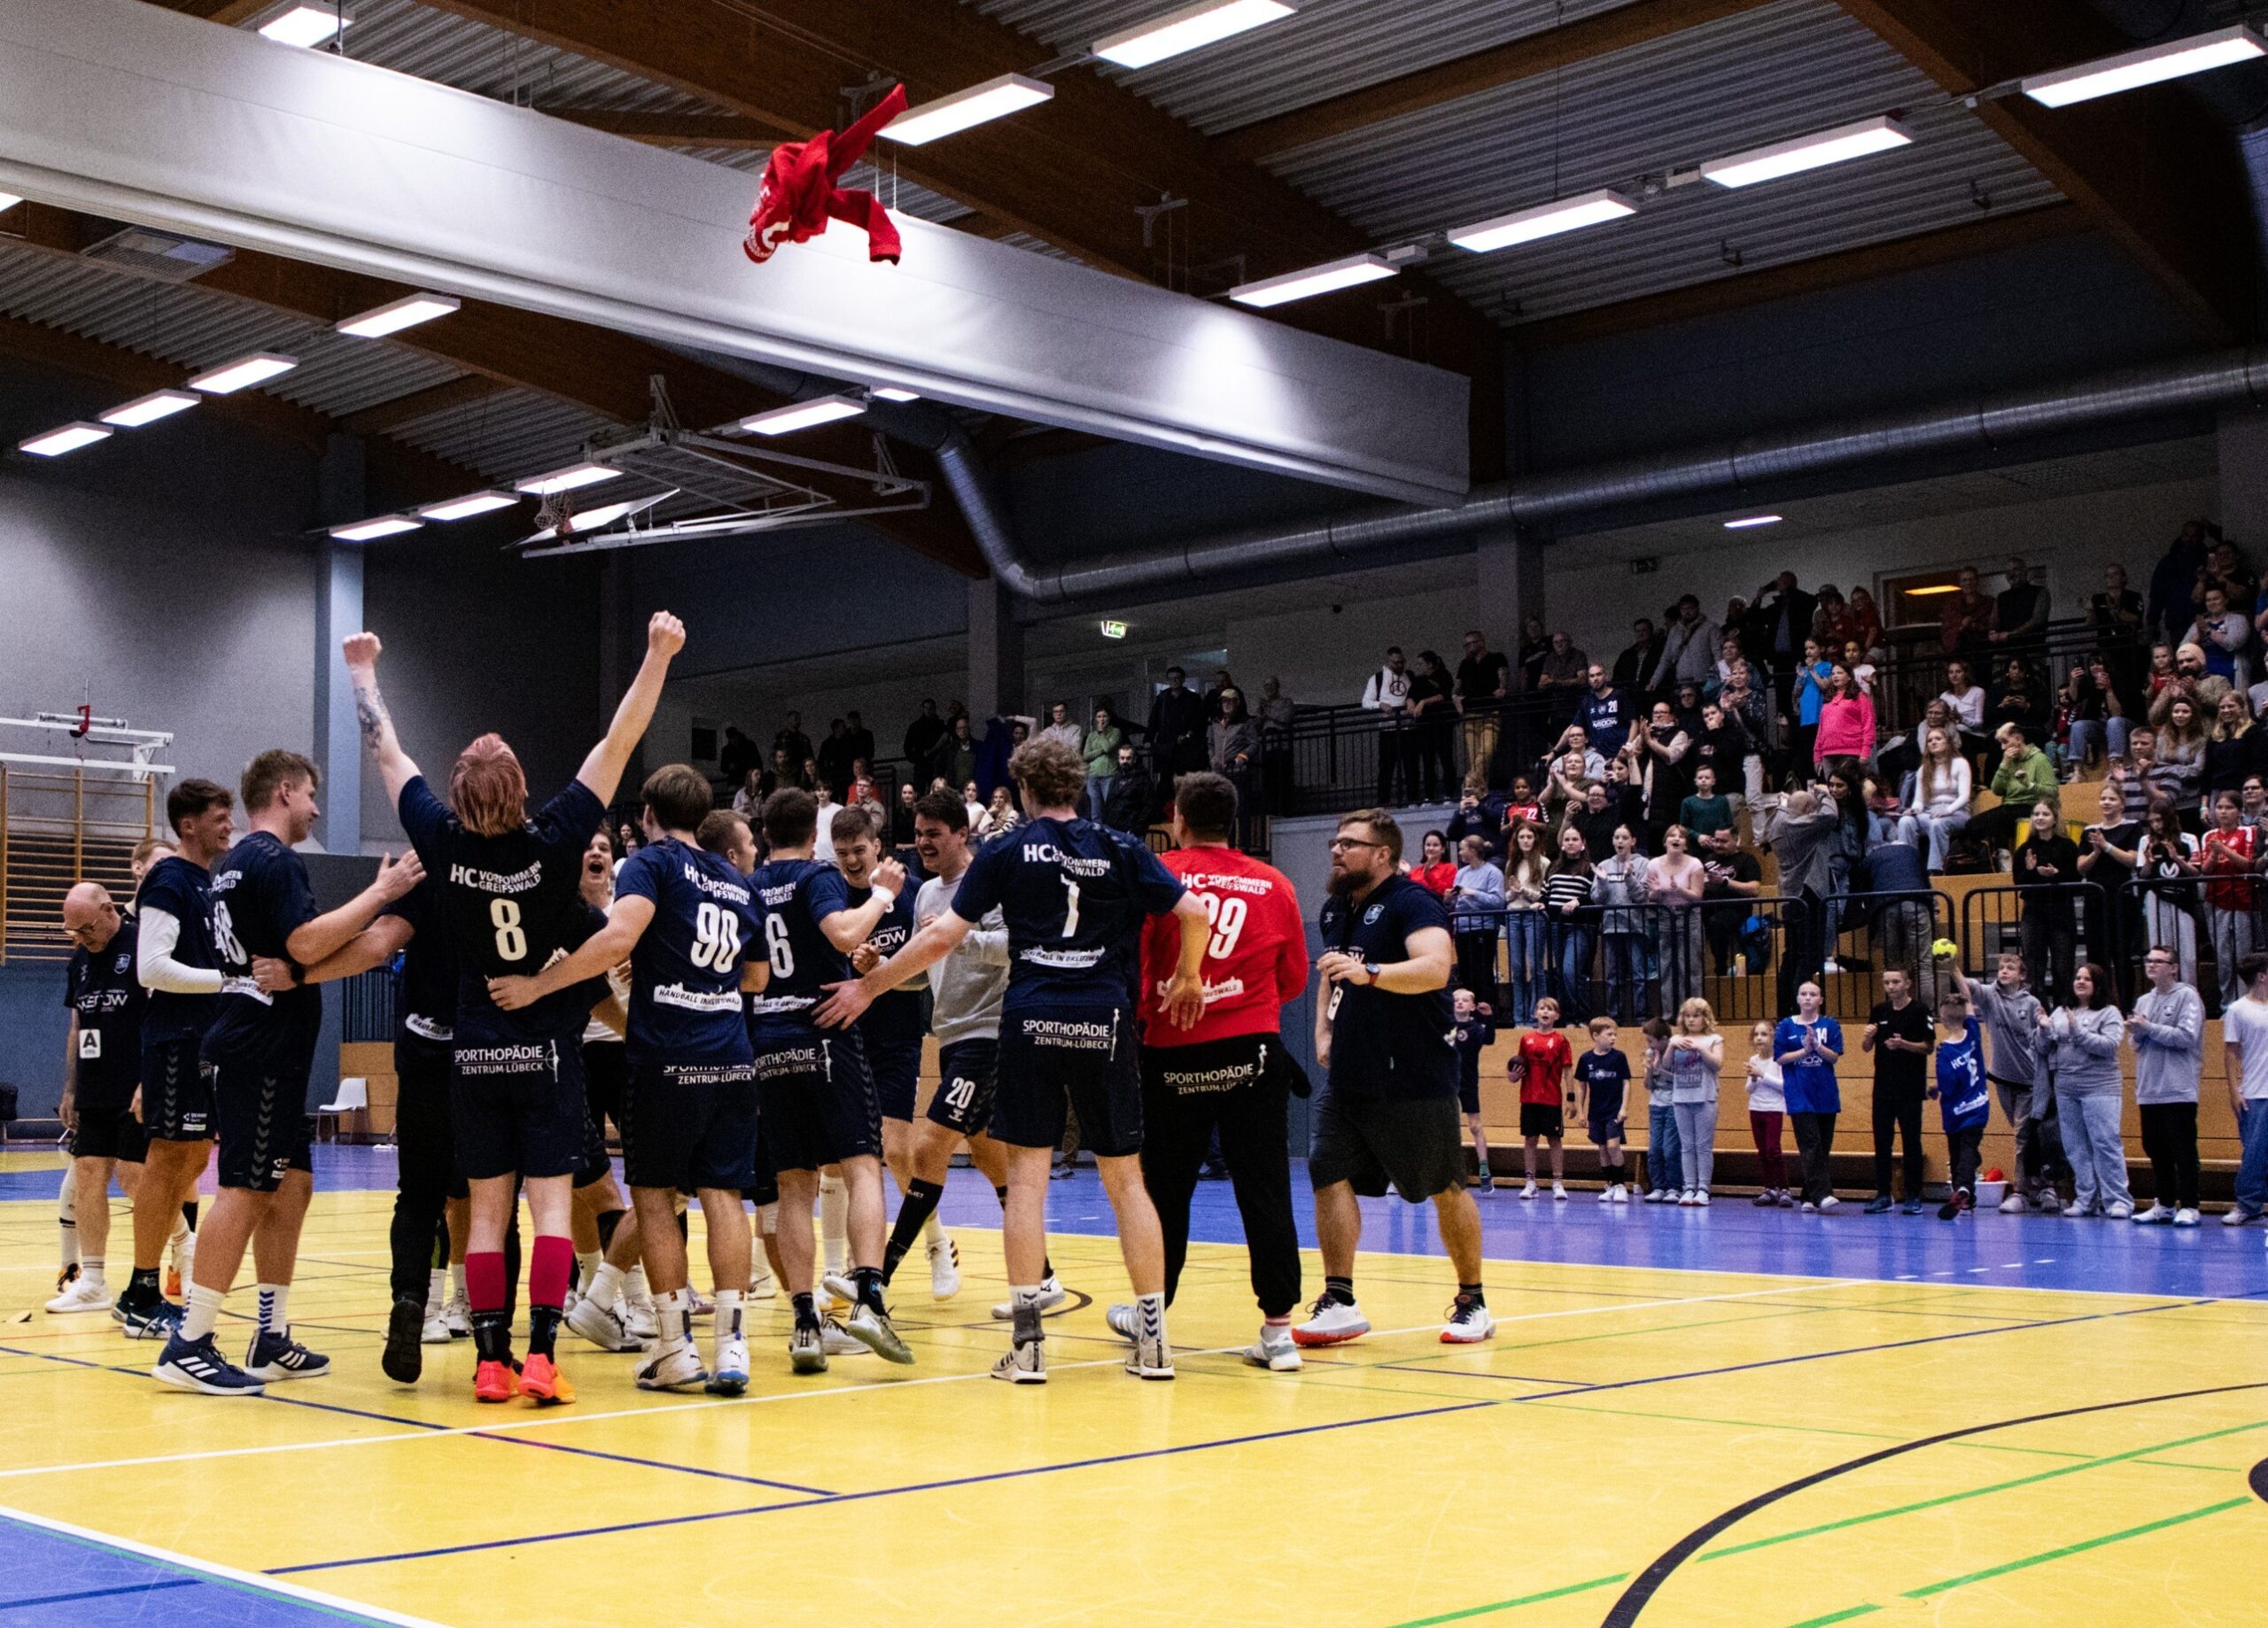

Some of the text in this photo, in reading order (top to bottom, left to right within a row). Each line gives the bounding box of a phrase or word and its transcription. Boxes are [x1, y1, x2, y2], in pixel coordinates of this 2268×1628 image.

[1023, 844, 1052, 862] HC
[1052, 846, 1110, 869] OMMERN
[450, 863, 478, 888] HC
[478, 873, 541, 894] GREIFSWALD
[1181, 872, 1207, 888] HC
[701, 873, 750, 900] VRPOMMERN
[702, 883, 748, 905] GIFSWALD
[490, 898, 527, 961] 8
[691, 903, 742, 973] 90
[869, 930, 905, 948] DOW
[765, 912, 795, 979] 6
[658, 989, 698, 1004] HANDBALL
[1022, 1019, 1109, 1037] SPORTHOPÄDIE
[82, 1032, 97, 1048] A
[454, 1044, 544, 1063] SPORTHOPÄDIE
[755, 1049, 816, 1069] ORTHOPÄDIE
[1163, 1063, 1254, 1084] SPORTHOPÄDIE
[945, 1077, 975, 1109] 20
